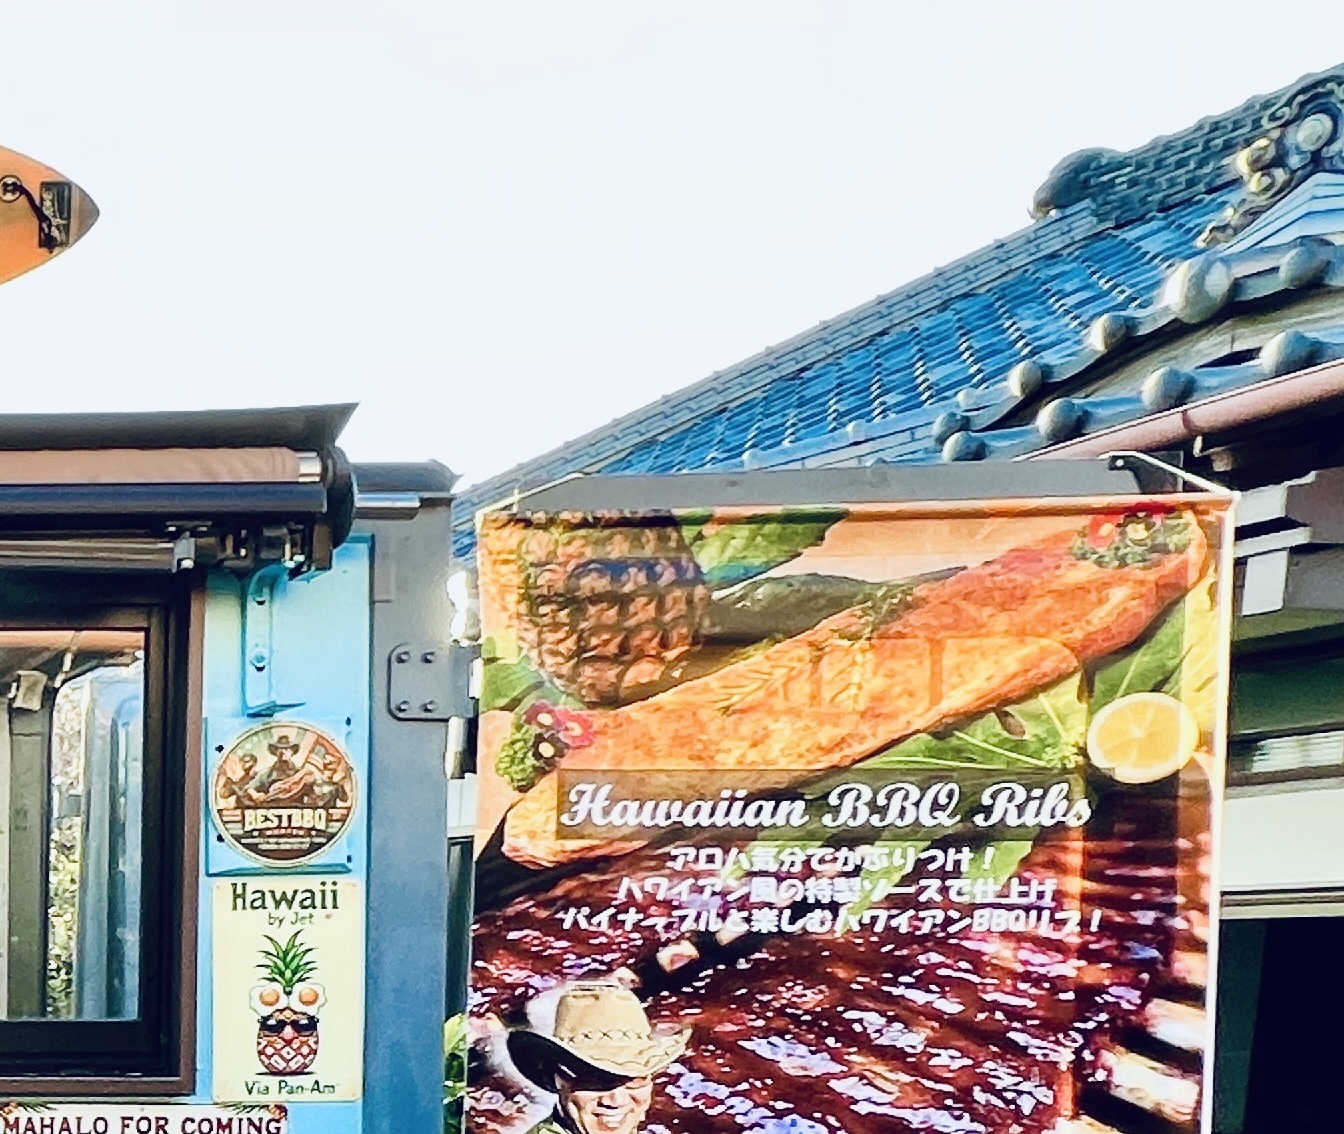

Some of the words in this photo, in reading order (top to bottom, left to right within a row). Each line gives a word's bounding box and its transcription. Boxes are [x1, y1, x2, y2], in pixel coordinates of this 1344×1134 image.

[559, 782, 810, 828] Hawaiian
[821, 782, 962, 828] BBQ
[972, 782, 1092, 828] Ribs
[230, 880, 340, 912] Hawaii
[267, 913, 285, 929] by
[289, 912, 316, 926] Jet
[244, 1079, 269, 1095] Via
[277, 1079, 337, 1095] Pan-Am
